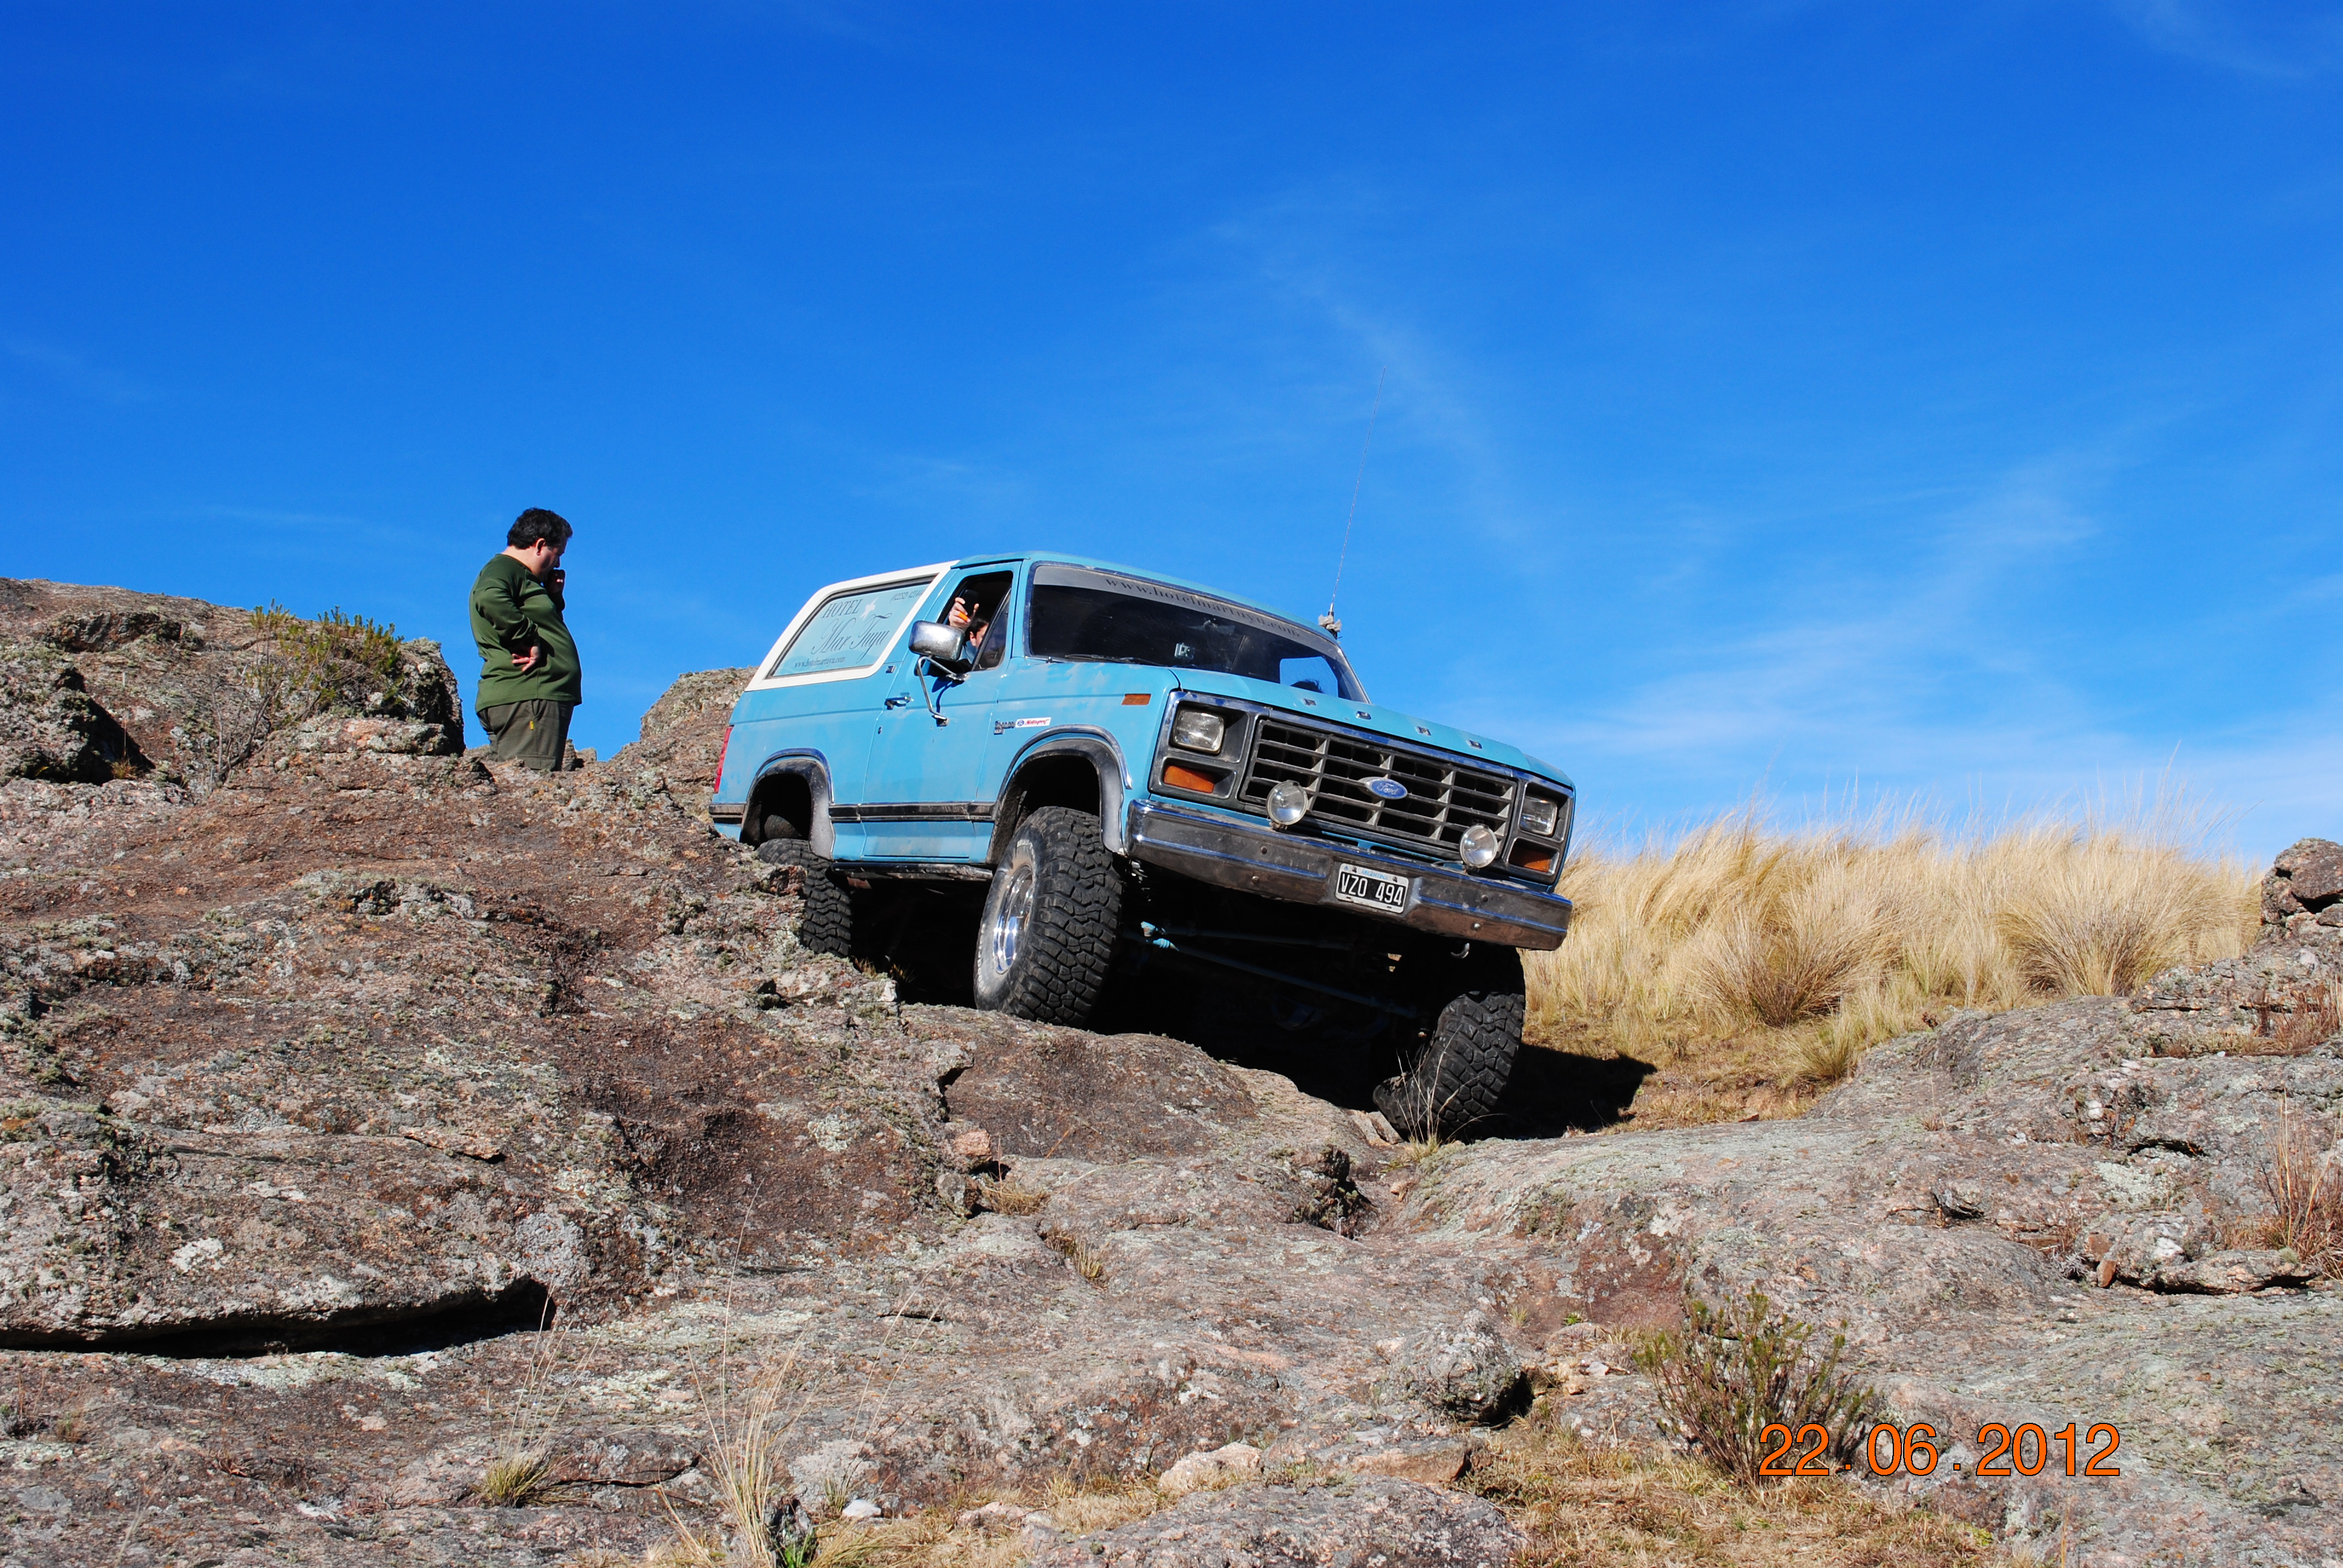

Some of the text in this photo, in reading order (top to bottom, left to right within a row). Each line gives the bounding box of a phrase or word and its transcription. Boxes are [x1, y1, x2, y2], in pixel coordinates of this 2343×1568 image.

[822, 599, 863, 618] HOTEL
[1106, 579, 1300, 637] www.hotelmartuyu.com
[811, 618, 856, 654] Mar
[1377, 782, 1399, 795] Ford
[1362, 869, 1388, 880] ARGENTINA
[1341, 873, 1404, 906] VZO 494
